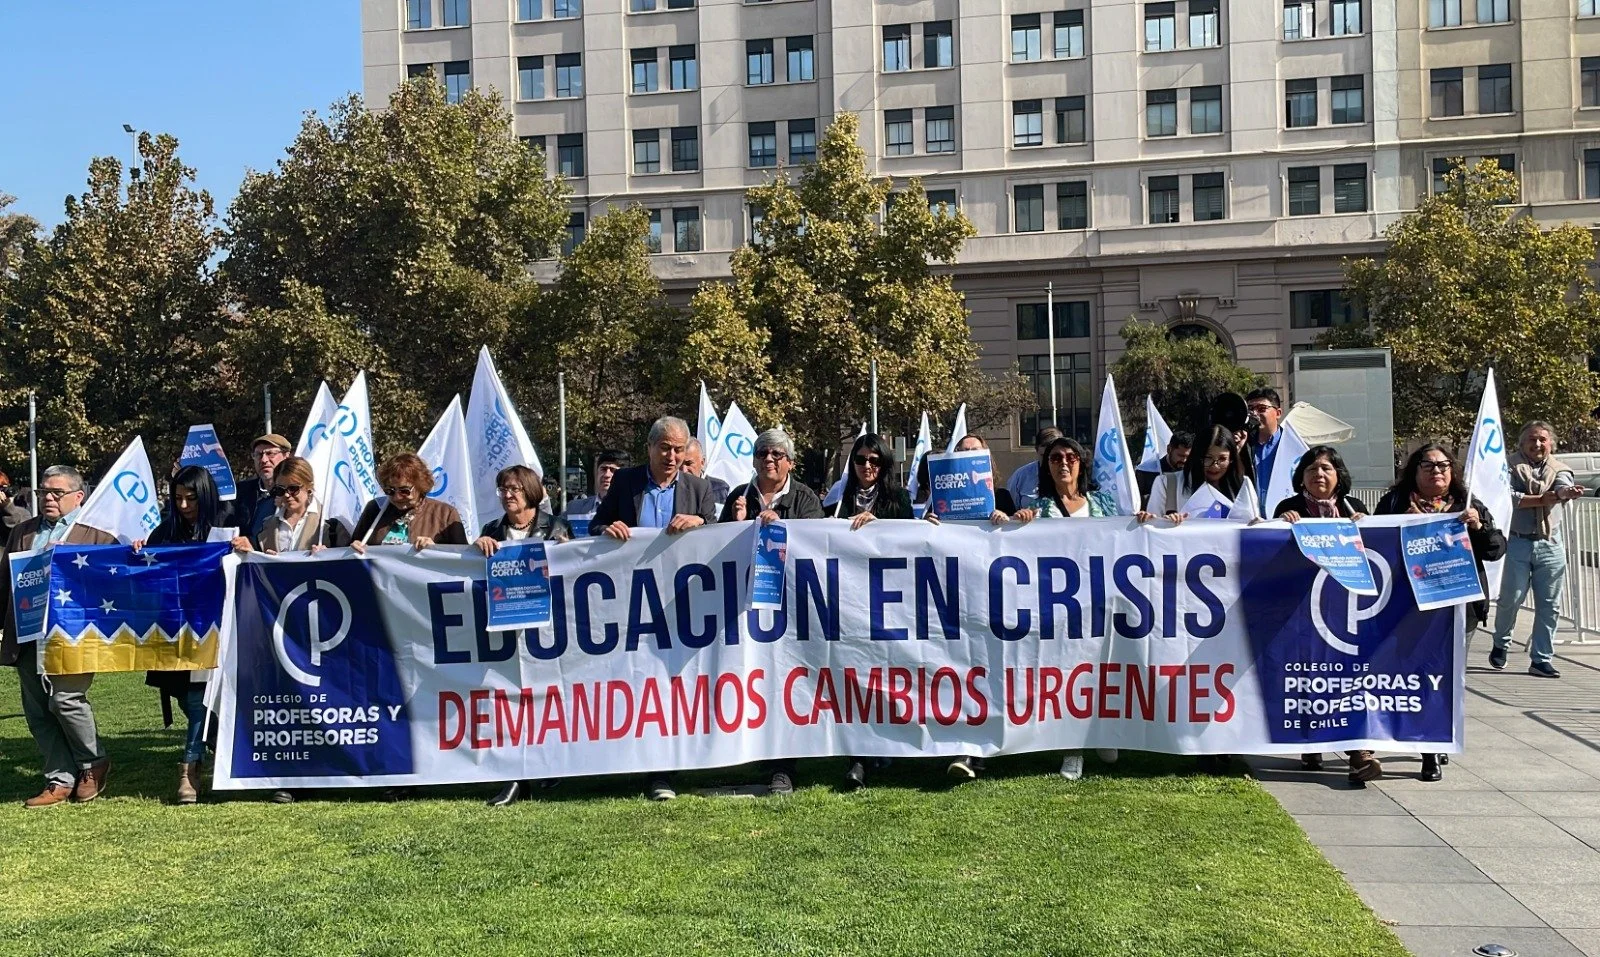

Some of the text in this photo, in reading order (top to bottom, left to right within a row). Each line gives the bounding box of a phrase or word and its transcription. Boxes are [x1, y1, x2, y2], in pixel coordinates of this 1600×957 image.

[935, 473, 969, 482] AGENDA
[935, 481, 967, 489] CORTA:
[1407, 536, 1443, 548] AGENDA
[1407, 545, 1441, 555] CORTA:
[491, 560, 526, 570] AGENDA
[491, 569, 523, 577] CORTA:
[869, 557, 961, 640] EN
[988, 554, 1227, 641] CRISIS
[1285, 663, 1370, 672] COLEGIO DE
[1284, 674, 1443, 693] PROFESORAS Y
[253, 693, 327, 704] COLEGIO DE
[438, 662, 1236, 751] DEMANDAMOS CAMBIOS URGENTES
[1284, 695, 1422, 715] PROFESORES
[253, 705, 402, 725] PROFESORAS Y
[1284, 717, 1349, 729] DE CHILE
[253, 727, 379, 746] PROFESORES
[253, 751, 310, 761] DE CHILE
